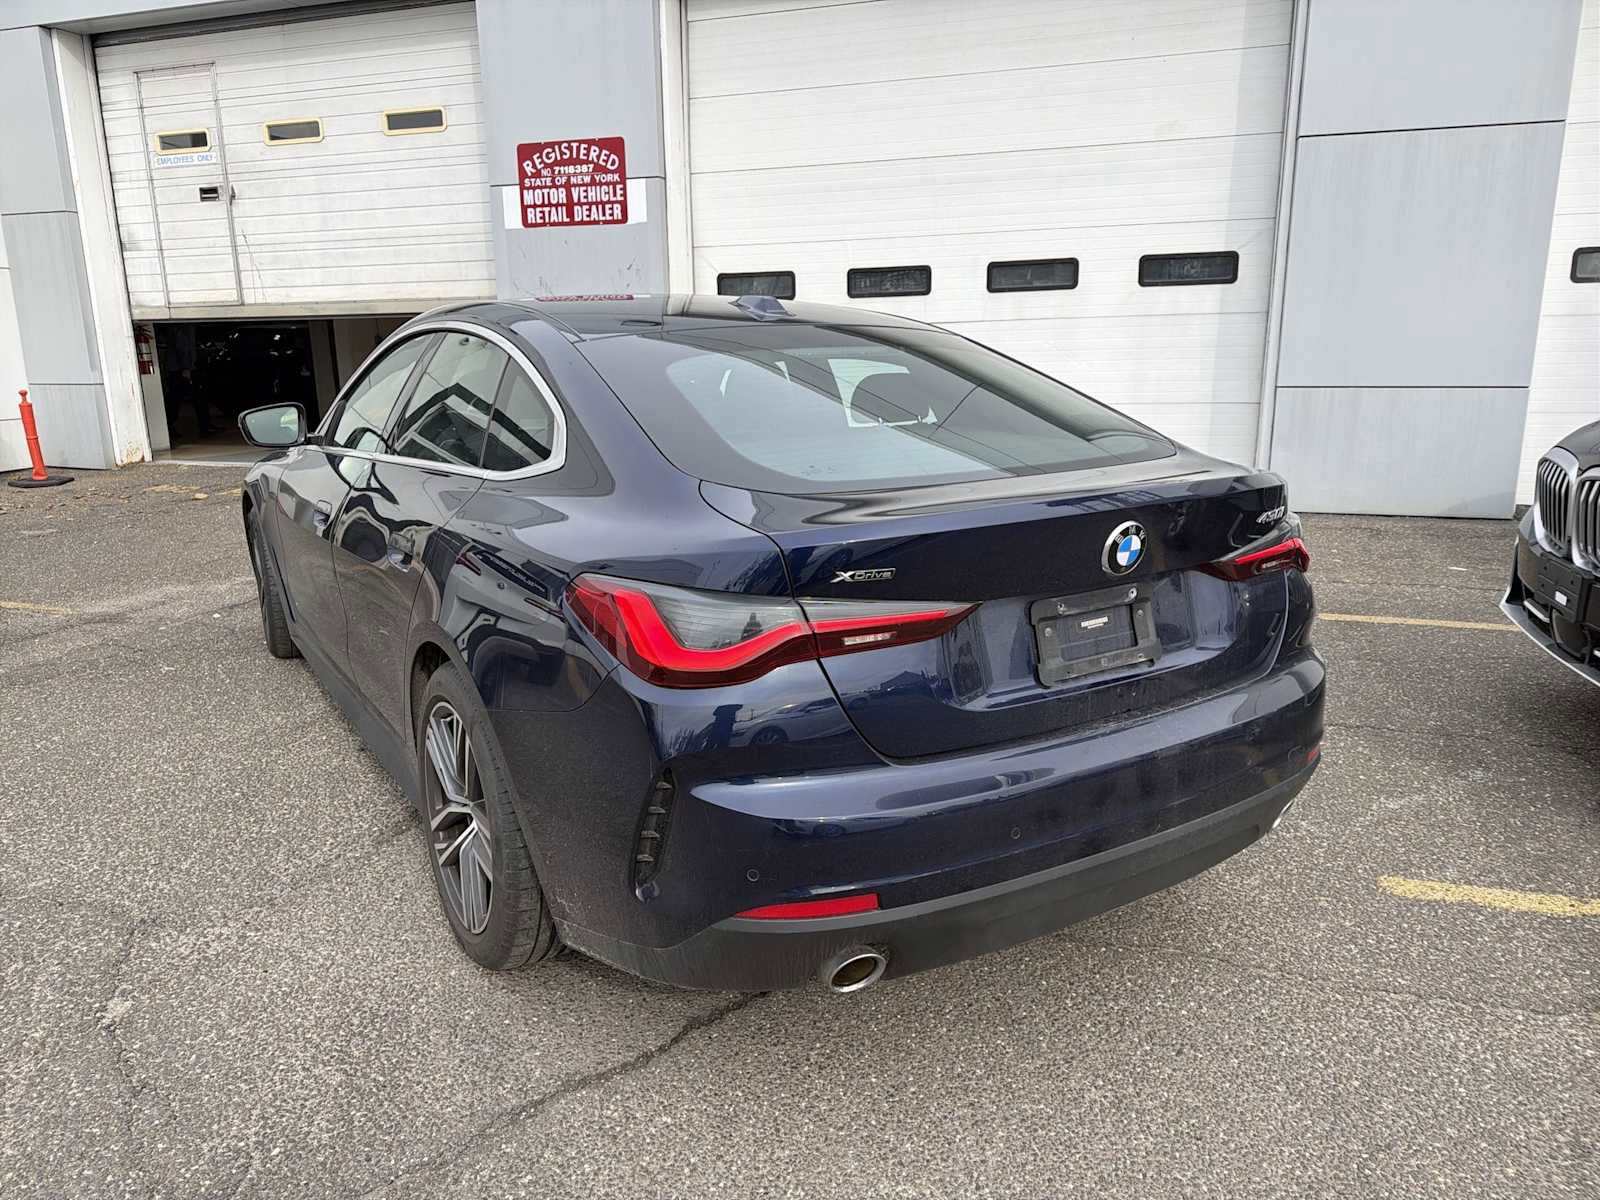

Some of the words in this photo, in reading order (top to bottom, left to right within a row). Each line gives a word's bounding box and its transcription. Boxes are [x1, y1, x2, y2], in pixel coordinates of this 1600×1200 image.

[523, 142, 620, 177] REGISTERED
[553, 164, 594, 174] 7118387
[524, 178, 552, 187] STATE
[555, 176, 567, 185] OF
[570, 175, 592, 184] NEW
[594, 173, 620, 183] YORK
[523, 187, 567, 206] MOTOR
[571, 184, 624, 203] VEHICLE
[527, 206, 570, 224] RETAIL
[573, 203, 622, 222] DEALER
